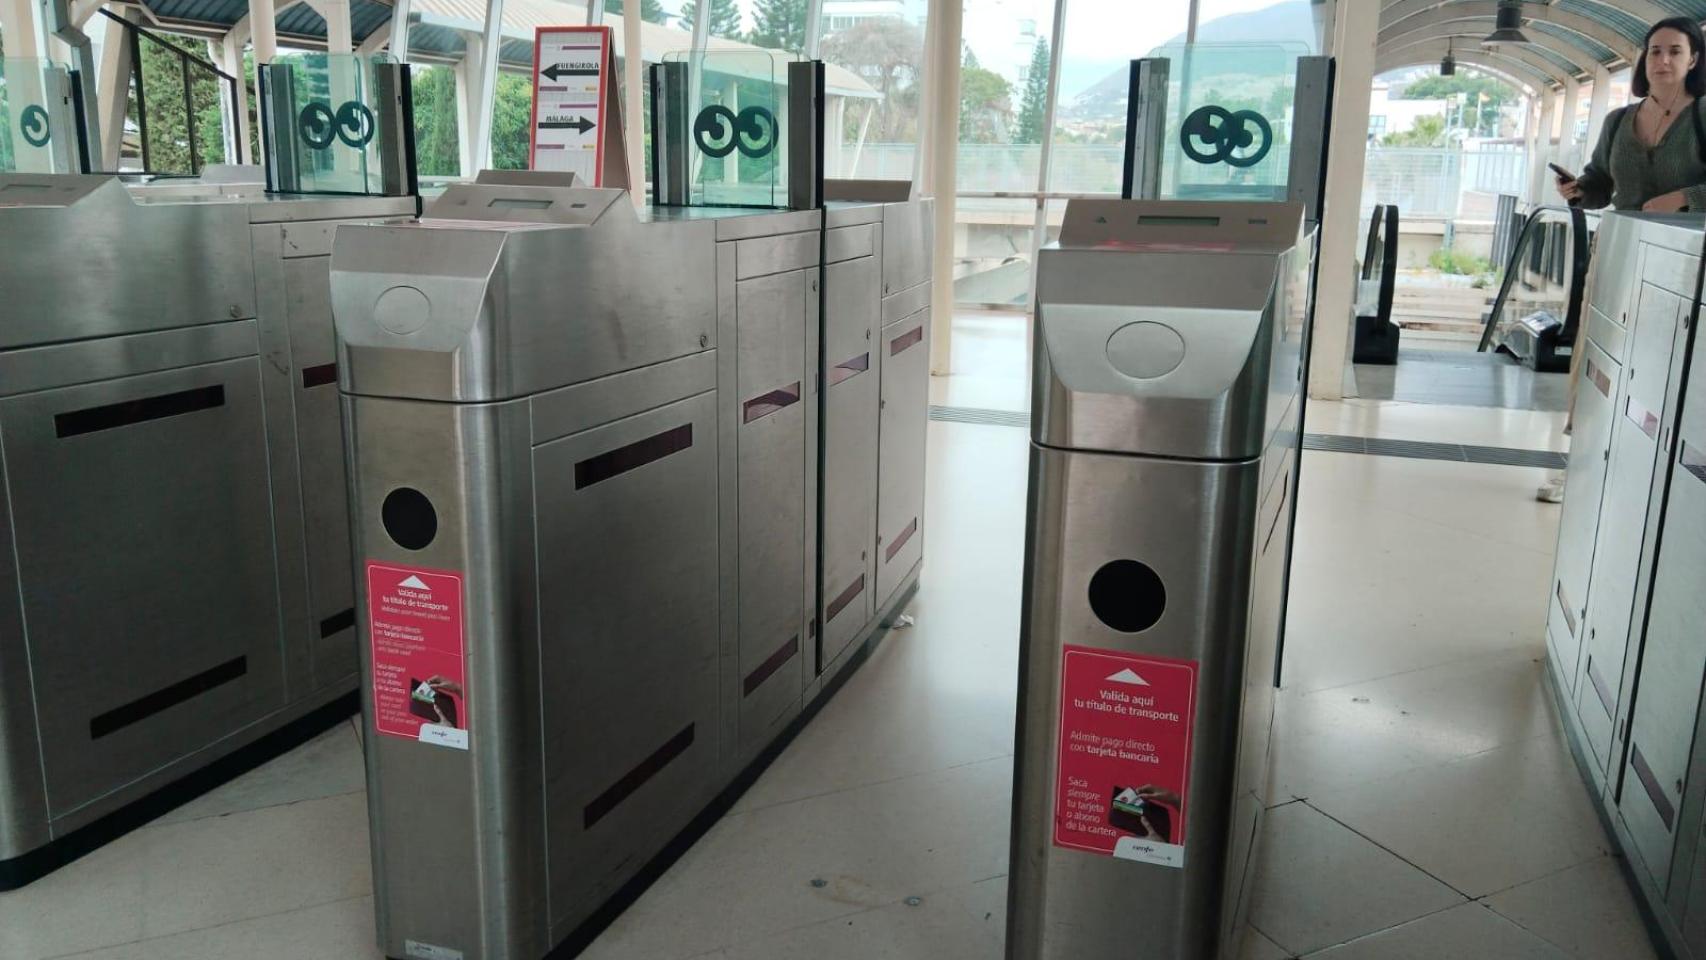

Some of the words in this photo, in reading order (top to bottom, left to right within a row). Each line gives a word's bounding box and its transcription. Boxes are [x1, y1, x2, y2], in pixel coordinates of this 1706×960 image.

[408, 598, 416, 607] de
[416, 600, 448, 610] transporte
[1100, 689, 1130, 702] Valida
[1132, 696, 1154, 707] aquí
[1074, 699, 1084, 708] tu
[1086, 699, 1112, 712] título
[1114, 704, 1127, 714] de
[1129, 706, 1179, 722] transporte
[1070, 730, 1100, 743] Admite
[1102, 736, 1124, 749] pago
[1126, 738, 1156, 752] directo
[1070, 744, 1086, 752] con
[1086, 744, 1116, 758] tarjeta
[1119, 750, 1160, 764] bancaria
[1067, 776, 1088, 788] Saca
[1067, 788, 1101, 800] siempre
[1067, 799, 1077, 808] tu
[1078, 800, 1104, 813] tarjeta
[1074, 810, 1100, 823] abono
[1066, 820, 1077, 831] de
[1078, 822, 1086, 832] la
[1088, 826, 1117, 838] cartera
